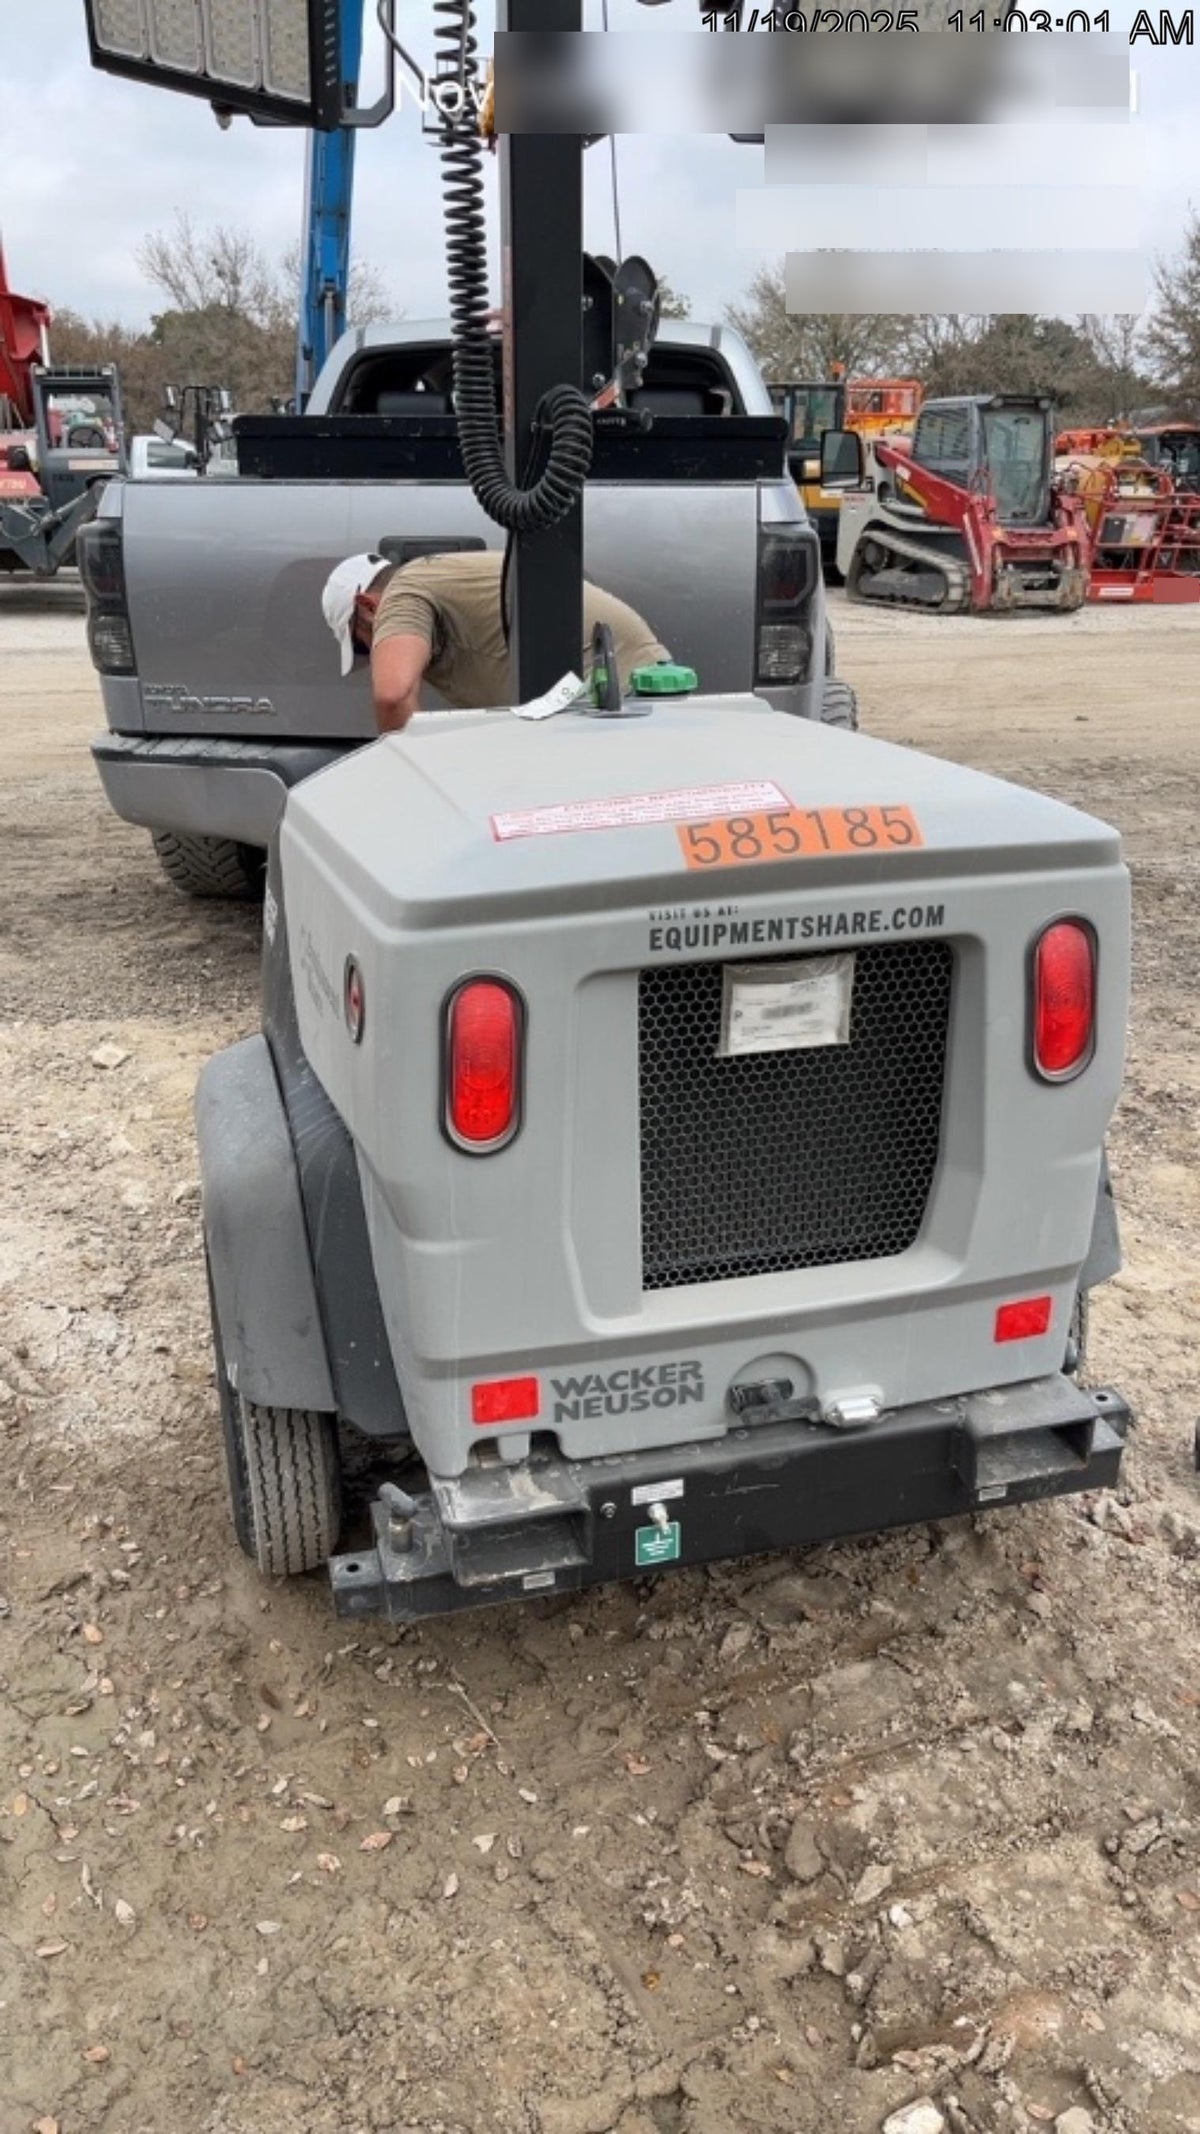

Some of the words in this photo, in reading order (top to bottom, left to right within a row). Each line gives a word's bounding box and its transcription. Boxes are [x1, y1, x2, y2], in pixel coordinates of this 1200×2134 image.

[687, 806, 916, 864] 585185
[649, 904, 945, 951] EQUIPMENTSHARE.COM
[550, 1360, 704, 1400] WACKER
[553, 1382, 705, 1424] NEUSON
